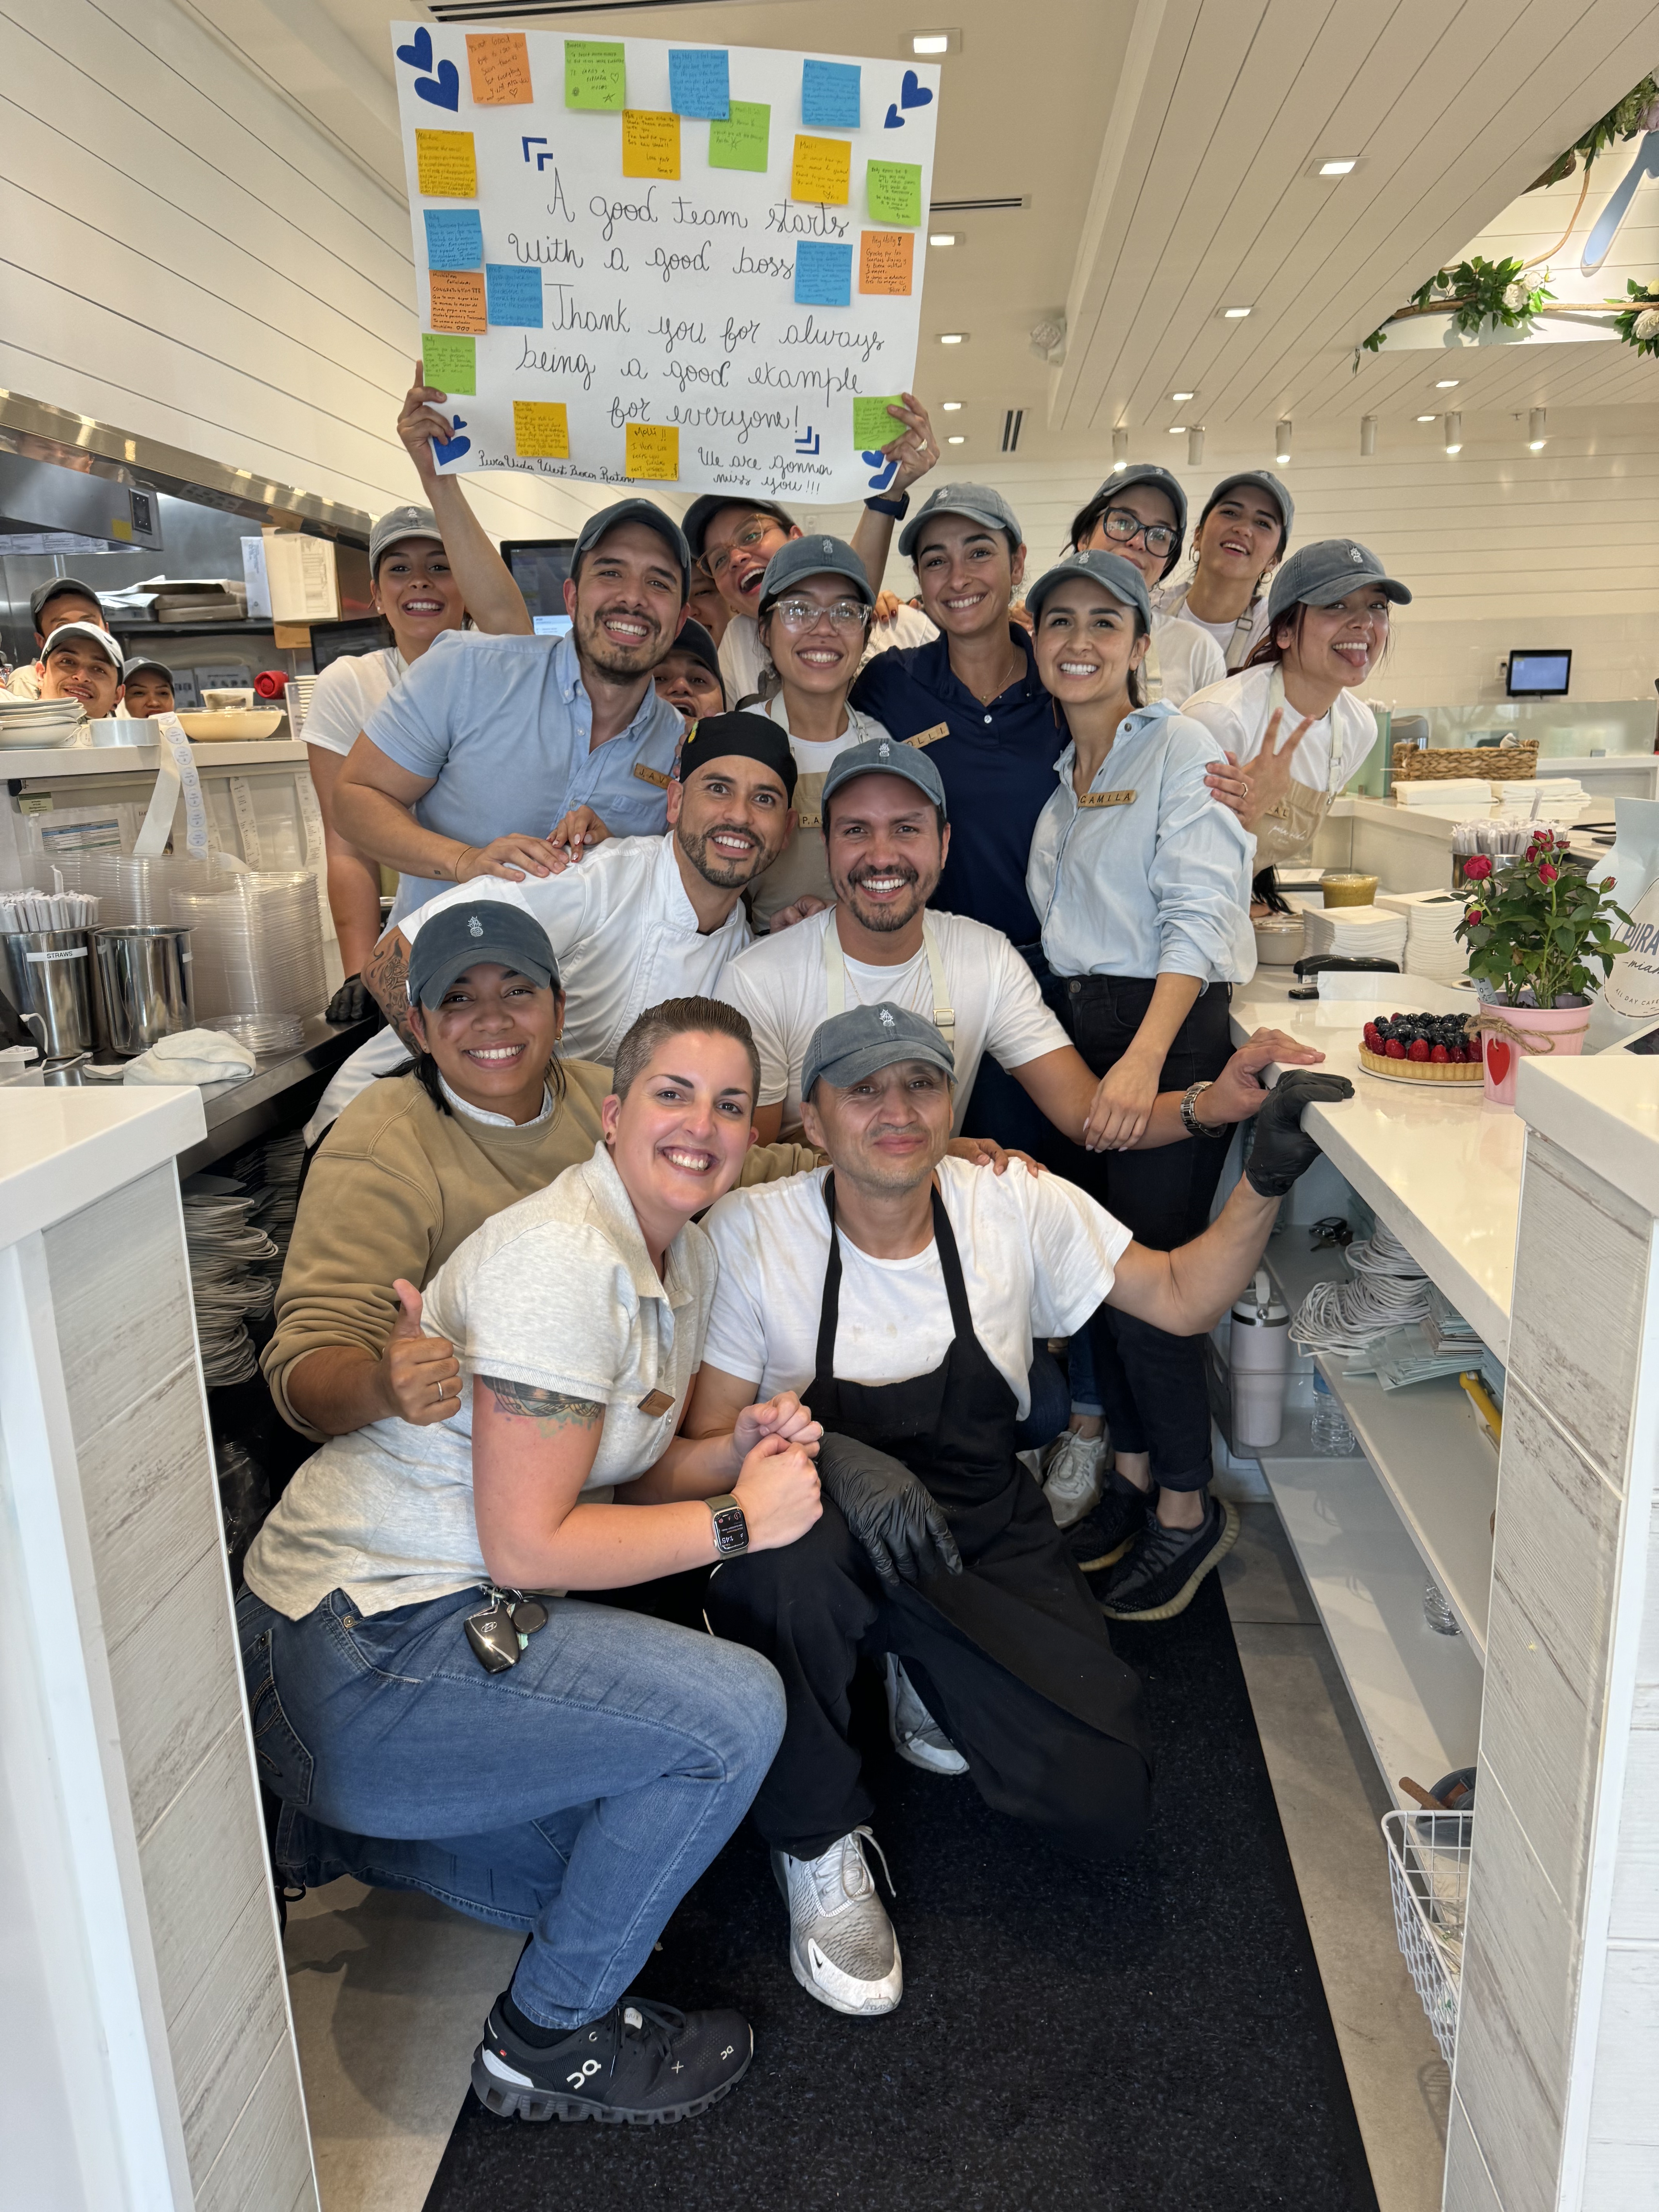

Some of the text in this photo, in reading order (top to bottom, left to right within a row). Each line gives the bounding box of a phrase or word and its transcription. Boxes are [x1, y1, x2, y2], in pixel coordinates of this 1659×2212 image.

[548, 167, 849, 241] A good team starts
[508, 234, 584, 268] With
[604, 247, 629, 271] a
[646, 240, 712, 282] good
[733, 247, 794, 279] boss
[872, 235, 881, 248] Hey
[544, 283, 630, 334] Thank
[648, 315, 706, 353] you
[720, 316, 760, 353] for
[779, 315, 884, 362] always
[515, 335, 596, 390] being
[621, 358, 648, 380] a
[663, 361, 731, 392] good
[606, 396, 799, 444] for everyone!
[698, 447, 832, 479] We are gonna
[713, 471, 750, 486] miss
[1080, 793, 1130, 804] CAMILA
[1624, 996, 1638, 1005] DAY
